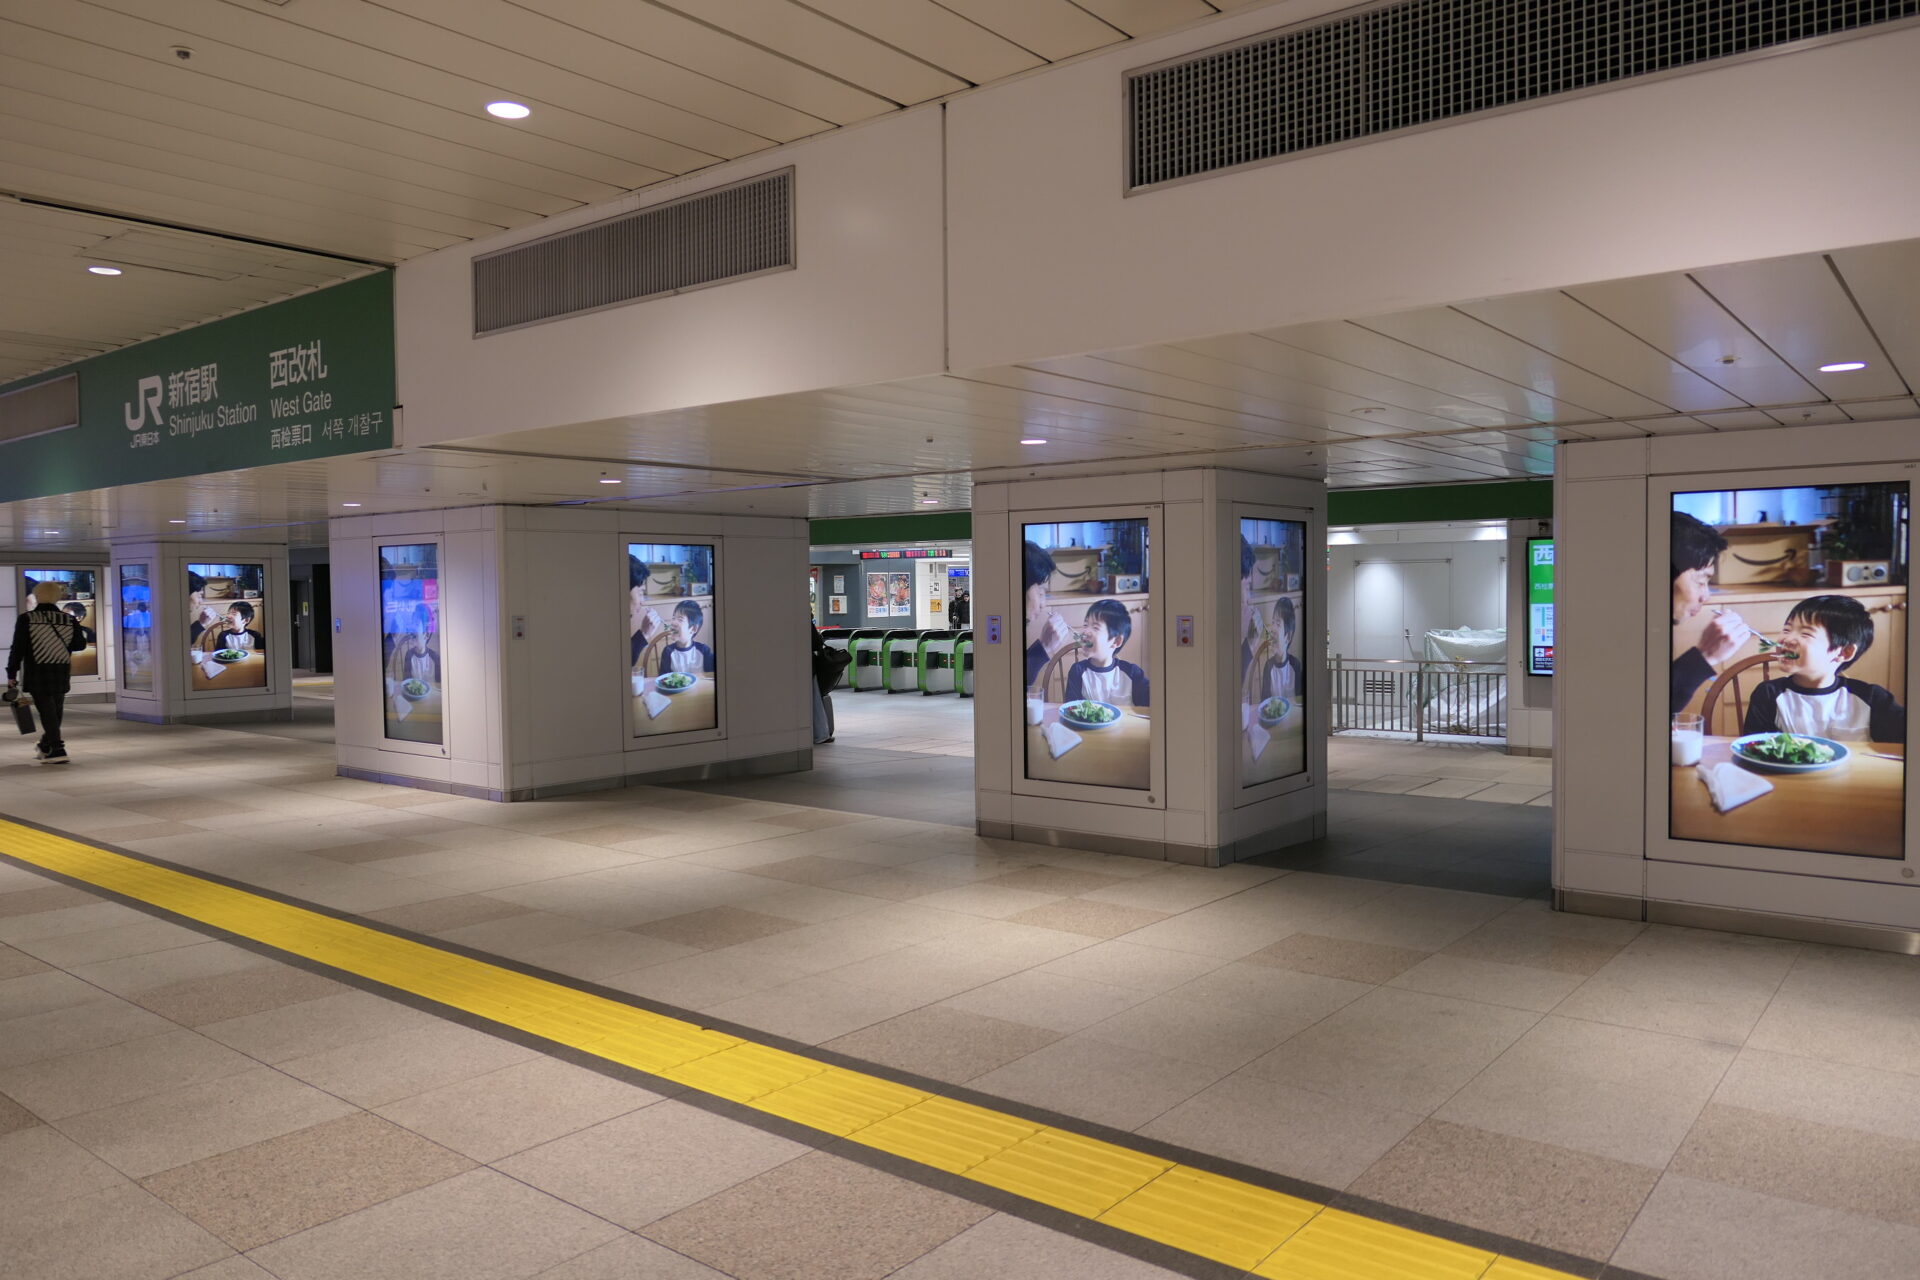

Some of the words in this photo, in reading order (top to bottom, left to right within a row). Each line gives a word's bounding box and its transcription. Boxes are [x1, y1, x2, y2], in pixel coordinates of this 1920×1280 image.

[269, 339, 328, 389] 西改札
[168, 362, 218, 409] 新宿駅
[124, 374, 164, 431] JR
[270, 395, 299, 419] West
[302, 390, 332, 413] Gate
[169, 410, 214, 438] Shinjuku
[217, 401, 257, 428] Station
[321, 418, 344, 441] 서쪽
[347, 411, 384, 437] 개찰구
[130, 431, 160, 448] JR東日本
[270, 424, 312, 450] 西检票口
